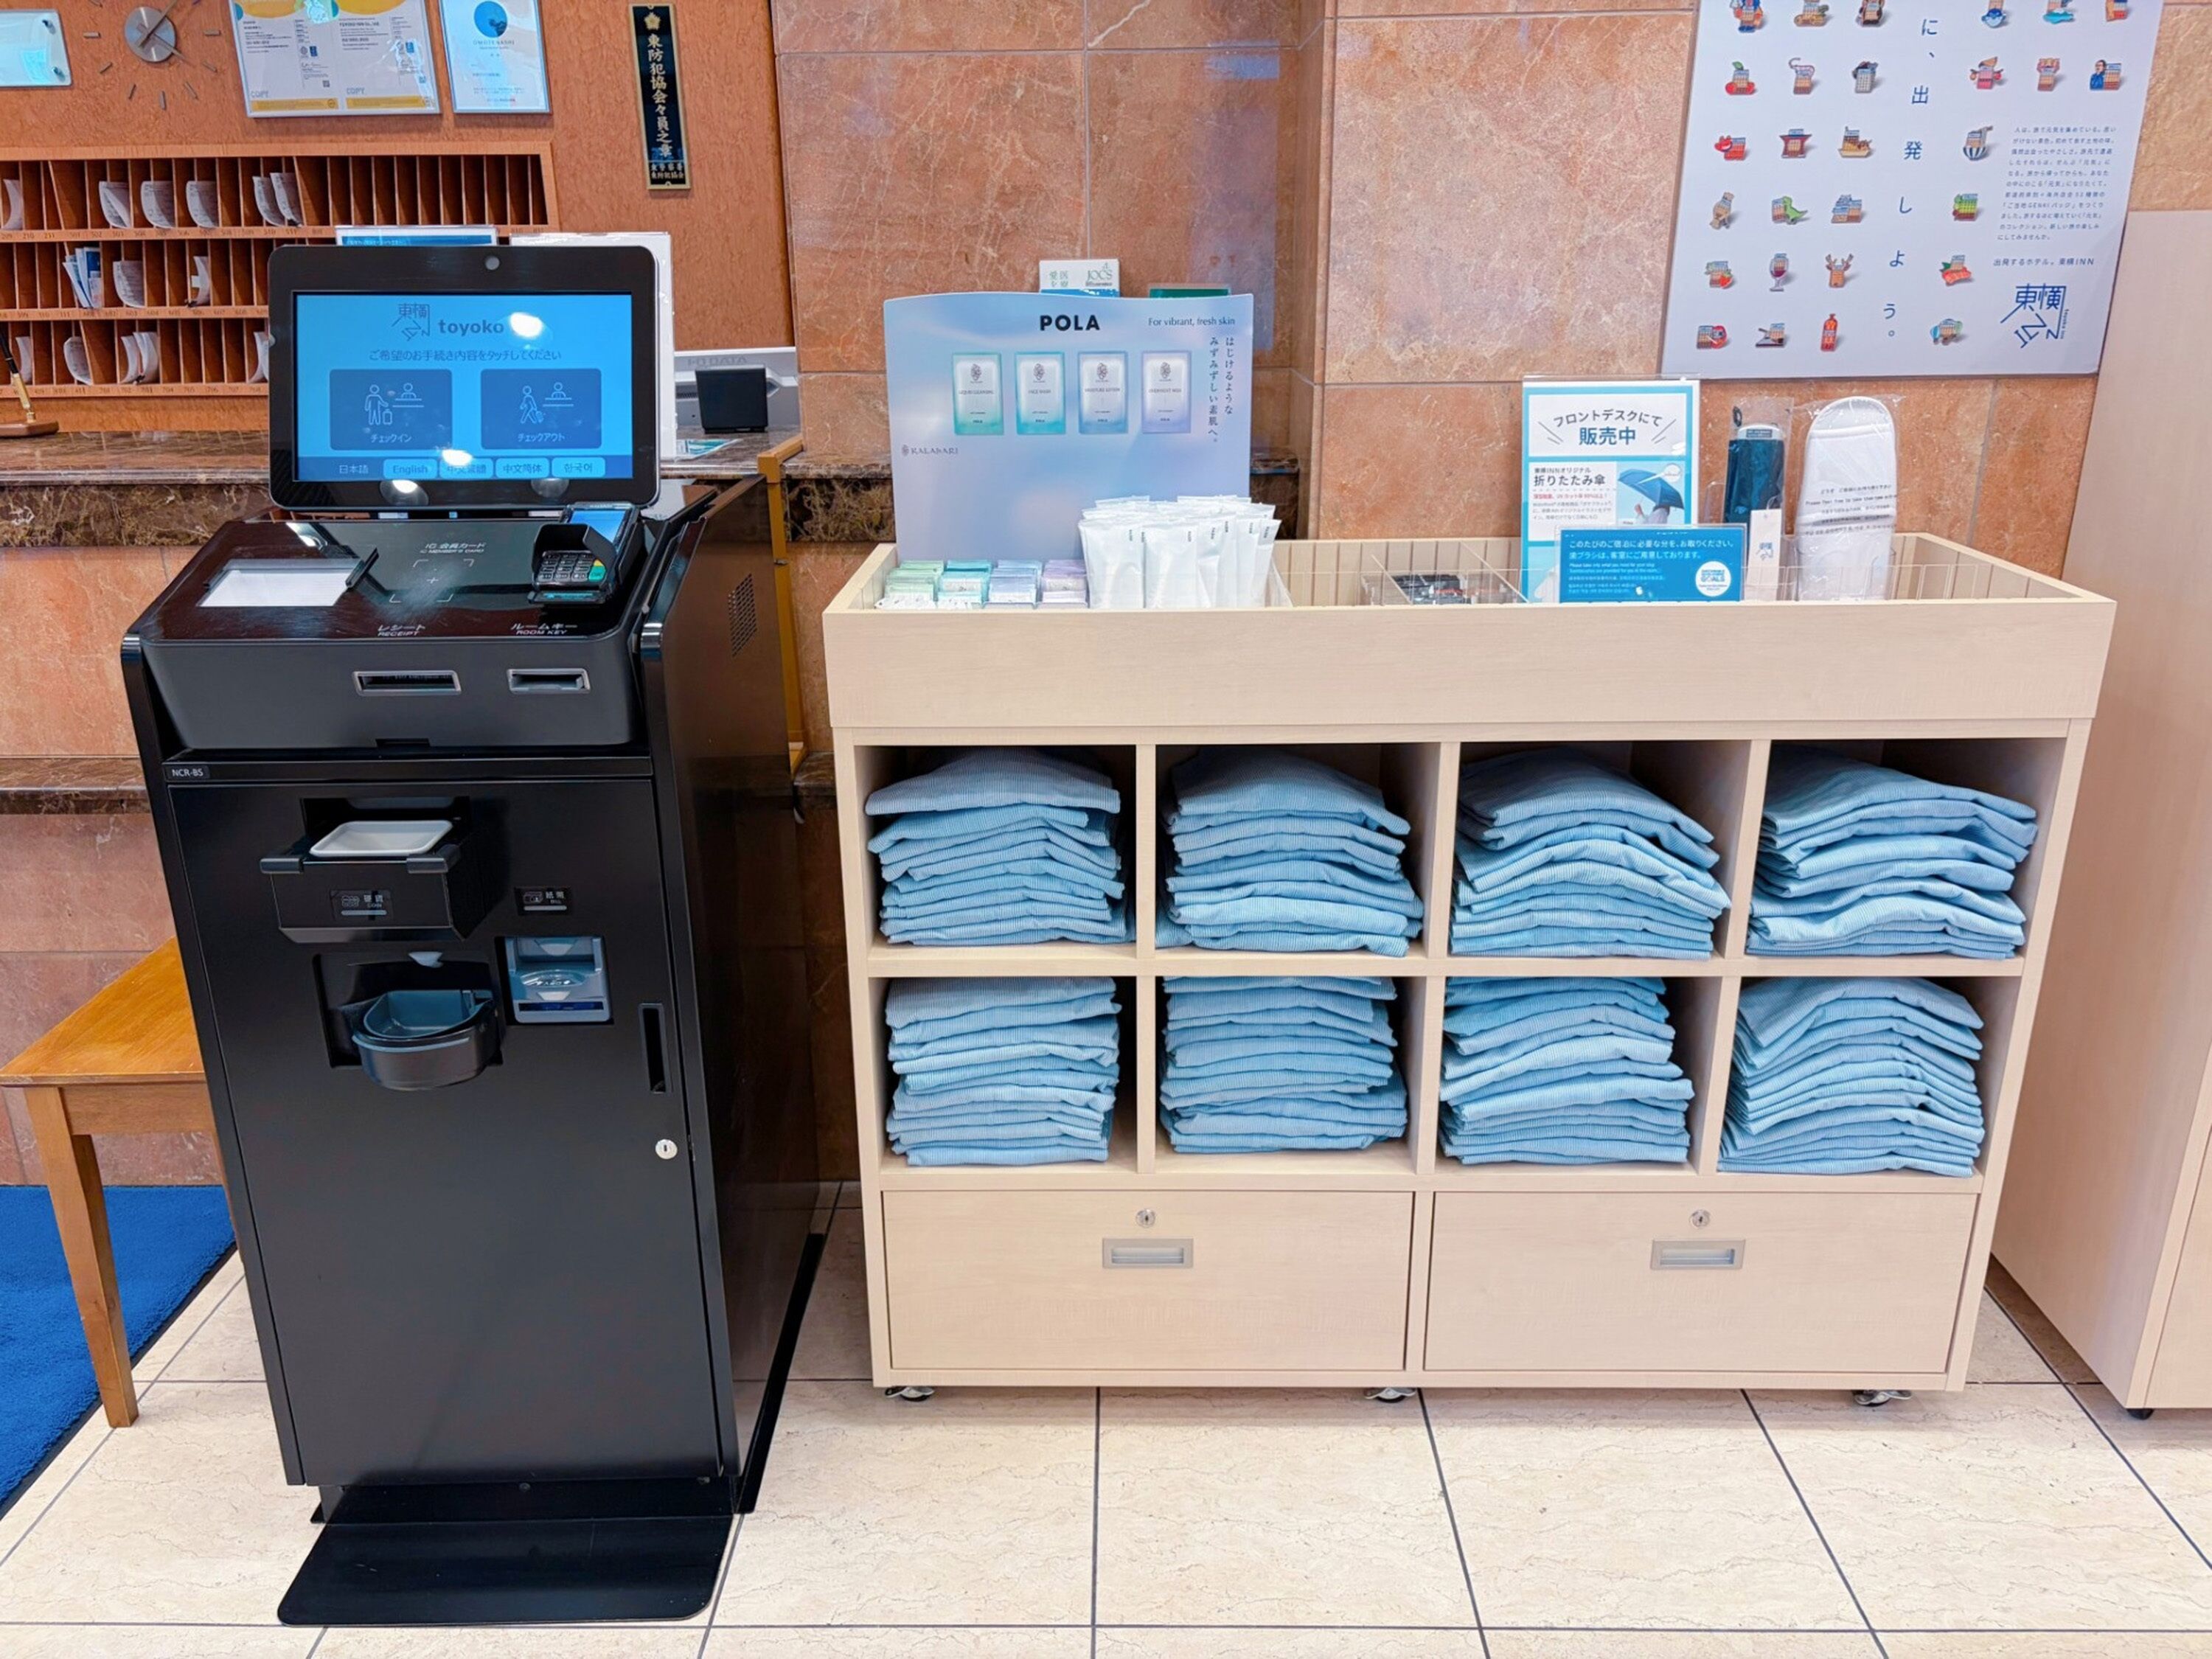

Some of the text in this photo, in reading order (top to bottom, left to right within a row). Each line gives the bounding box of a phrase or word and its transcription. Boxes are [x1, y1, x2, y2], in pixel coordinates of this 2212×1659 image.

[1040, 315, 1101, 332] POLA
[1148, 316, 1237, 327] For vibrant, fresh skin
[438, 319, 504, 337] toyoko
[369, 349, 562, 361] ご希望のお手続き内容をタッチしてください
[1225, 336, 1235, 415] はじけるような
[1554, 408, 1663, 428] フロントデスクにて
[370, 433, 413, 443] チェックイン
[518, 432, 566, 443] チェックアウト
[1579, 425, 1636, 445] 販売中
[338, 465, 369, 475] 日本語
[392, 465, 428, 476] English
[1534, 474, 1606, 487] 折りたたみ傘
[510, 622, 578, 630] ルームキー
